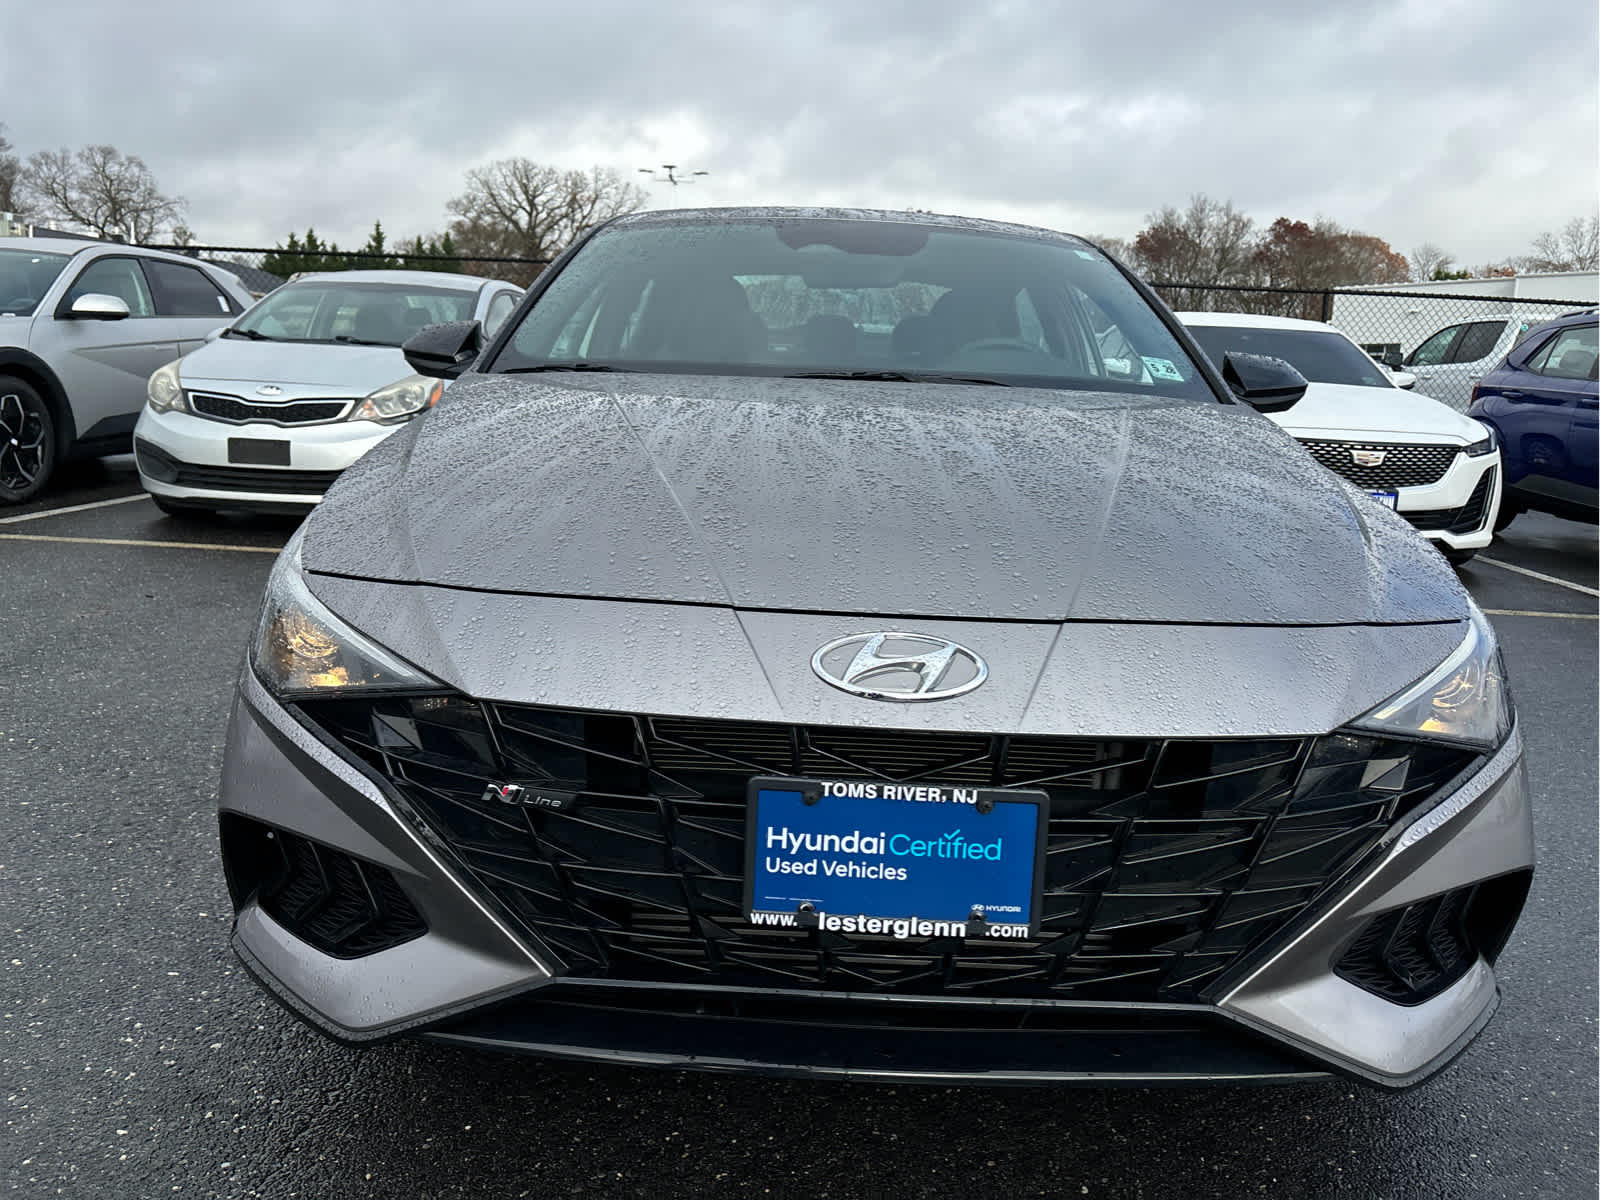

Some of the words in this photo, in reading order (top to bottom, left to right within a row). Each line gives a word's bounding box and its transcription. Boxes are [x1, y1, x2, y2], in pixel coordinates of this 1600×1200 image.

[524, 794, 561, 807] Line
[821, 782, 877, 799] TOMS
[883, 785, 947, 803] RIVER,
[952, 788, 978, 804] NJ
[766, 826, 886, 855] Hyundai
[889, 829, 1003, 861] Certified
[766, 856, 818, 875] Used
[822, 859, 908, 881] Vehicles
[985, 904, 1022, 913] HYUNDAI
[750, 912, 798, 927] www.
[818, 911, 966, 939] lesterglenn
[985, 925, 1029, 939] .com
